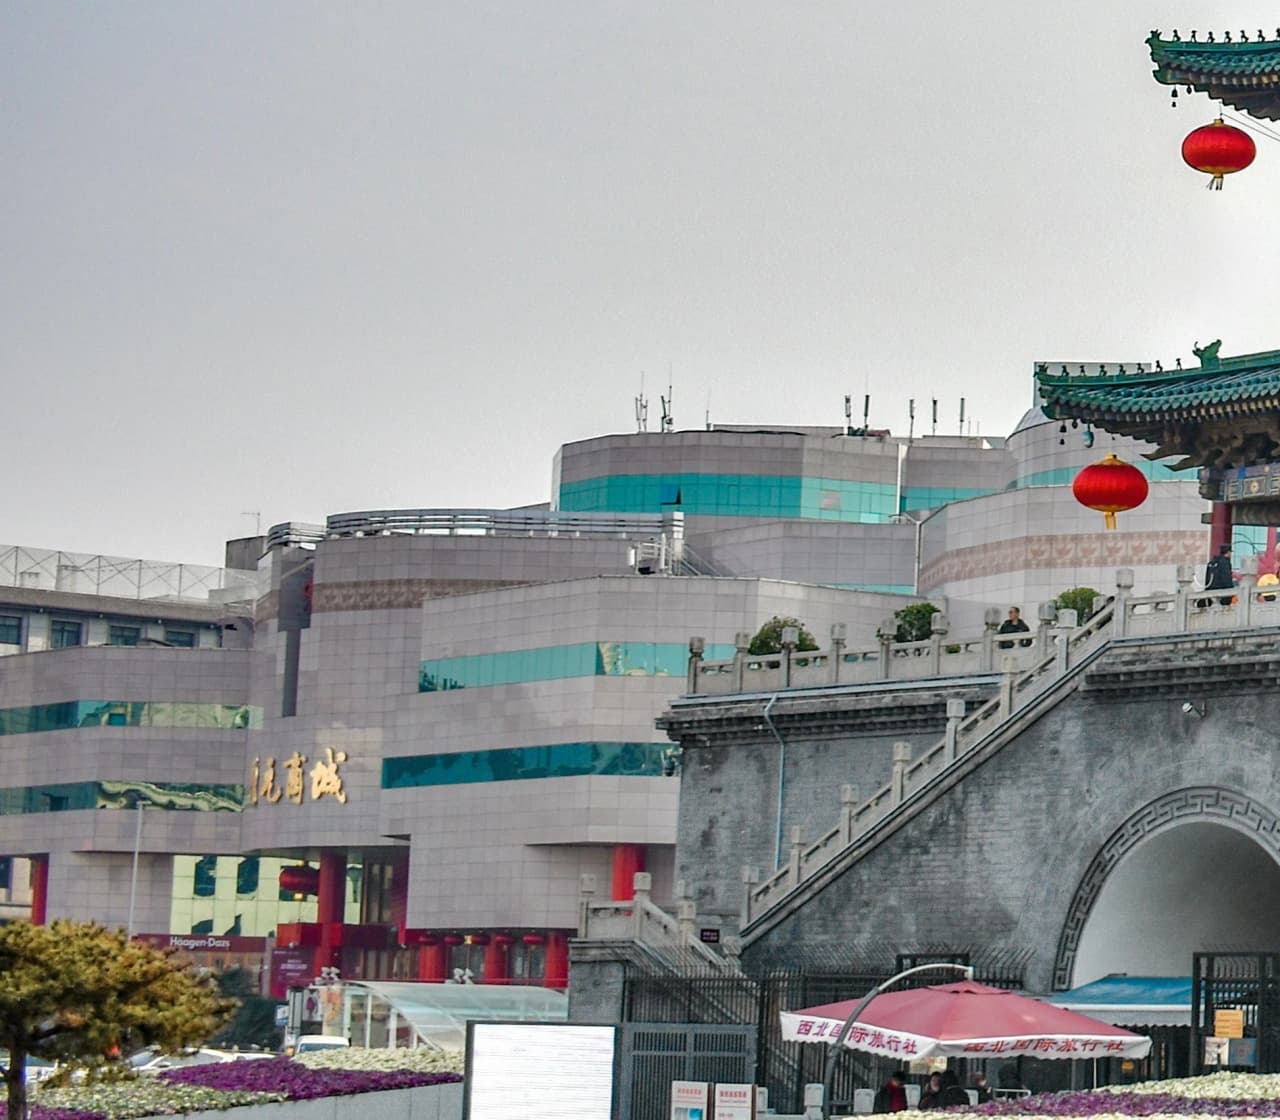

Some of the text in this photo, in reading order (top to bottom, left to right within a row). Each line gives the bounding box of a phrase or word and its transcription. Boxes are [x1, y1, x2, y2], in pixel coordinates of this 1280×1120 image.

[797, 1019, 918, 1055] 西北国际旅行社
[963, 1038, 1125, 1053] 西北国际旅行社
